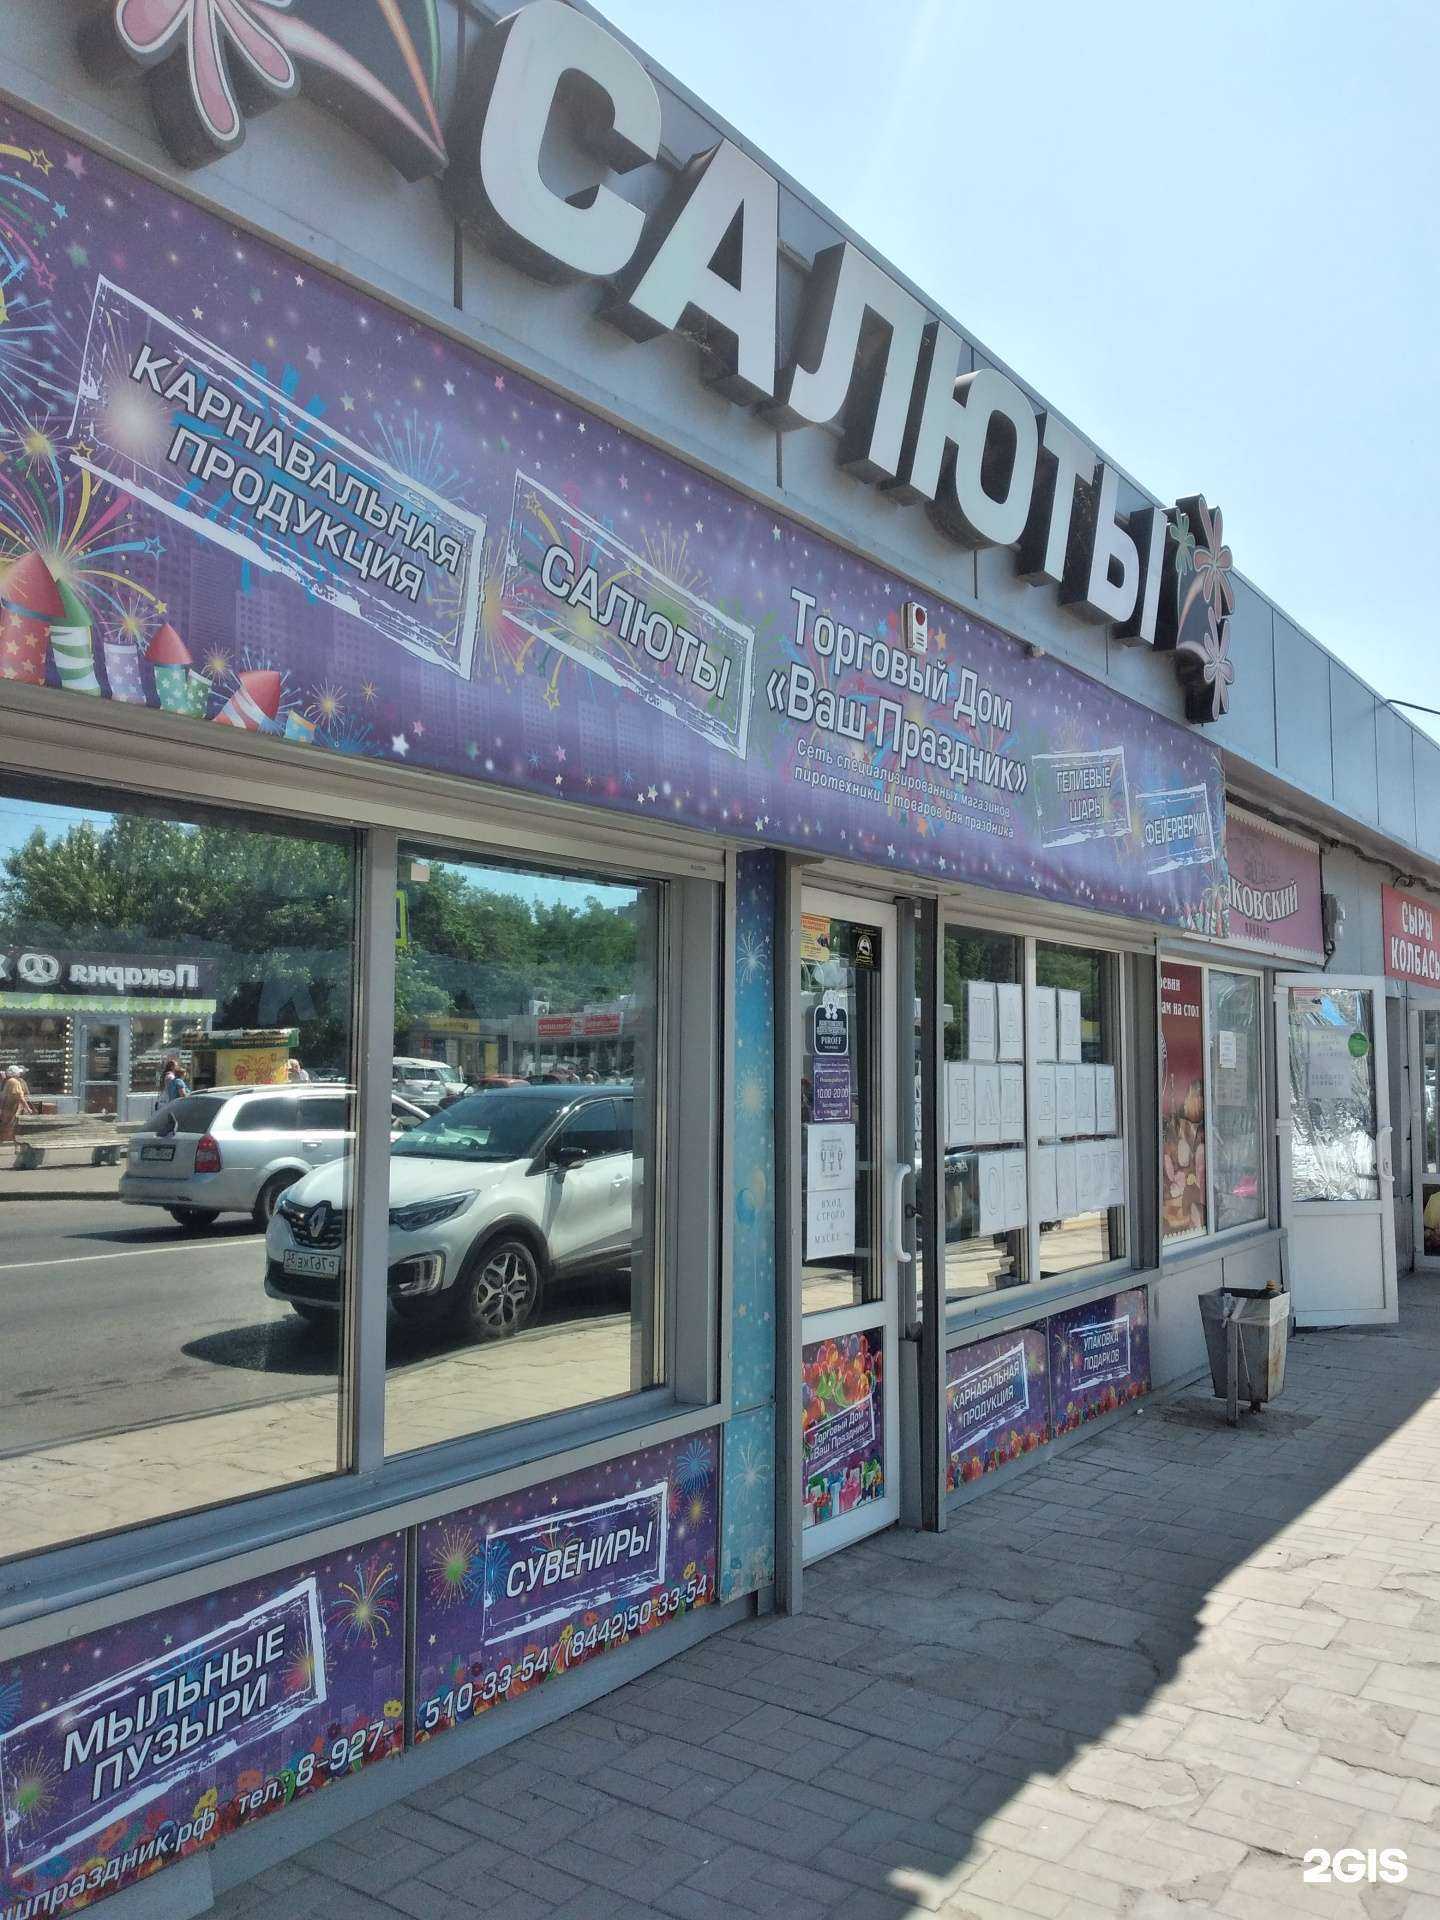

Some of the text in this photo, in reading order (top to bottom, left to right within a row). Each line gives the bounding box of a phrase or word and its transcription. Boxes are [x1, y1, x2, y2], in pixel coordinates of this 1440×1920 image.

[480, 0, 1168, 648] САЛЮТЫ
[130, 345, 465, 573] КАРНАВАЛЬНАЯ
[167, 427, 424, 602] ПРОДУКЦИЯ
[540, 544, 732, 700] САЛЮТЫ
[791, 587, 1013, 732] Торговый Дом
[766, 662, 1028, 795] «Ваш Праздник»
[794, 766, 1014, 839] пиротехники и товаров для праздника
[797, 738, 1010, 818] Сеть специализированных магазинов
[1056, 766, 1112, 793] ГЕЛИЕВЫЕ
[1069, 796, 1105, 822] ШАРЫ
[1145, 812, 1209, 846] ФЕЙЕРВЕРКИ
[1227, 874, 1299, 921] КОВСКИЙ
[1401, 901, 1433, 942] СЫРЫ
[1083, 1329, 1119, 1352] УПАКОВКА
[1084, 1350, 1120, 1371] ПОДАРКОВ
[953, 1361, 1020, 1411] КАРНАВАЛЬНАЯ
[962, 1385, 1014, 1428] ПРОДУКЦИЯ
[506, 1521, 653, 1598] СУВЕНИРЫ
[62, 1624, 286, 1772] МЫЛЬНЫЕ
[91, 1674, 268, 1802] ПУЗЫРИ
[0, 1807, 216, 1920] шпраздник.рф
